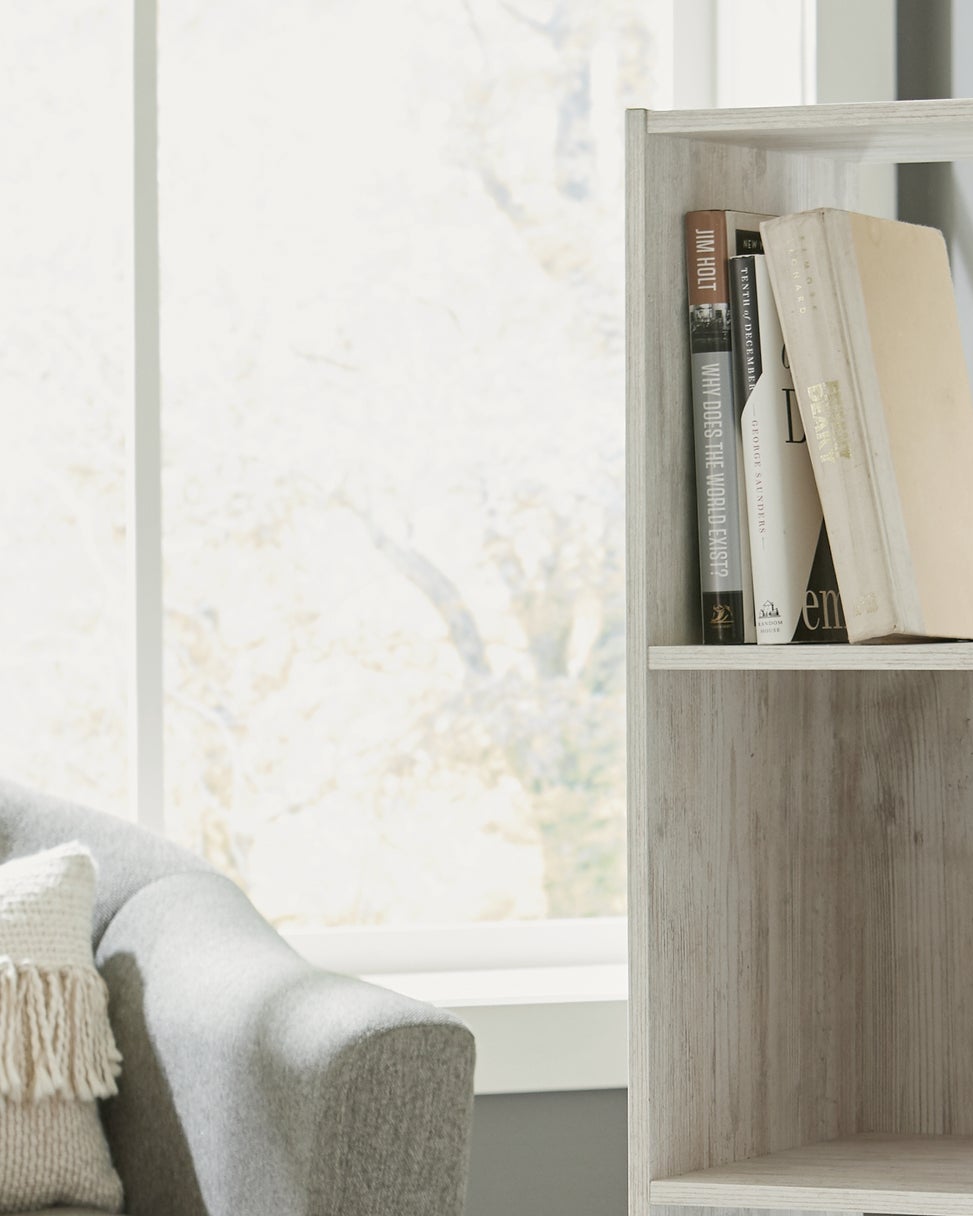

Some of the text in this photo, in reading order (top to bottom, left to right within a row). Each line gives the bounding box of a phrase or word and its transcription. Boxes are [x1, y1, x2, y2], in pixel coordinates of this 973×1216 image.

[696, 229, 717, 291] JIM HOLT
[743, 239, 757, 249] NEW
[740, 267, 757, 391] TENTH of DECEMBER
[701, 363, 728, 577] WHY DOES THE WORLD EXIST?
[751, 419, 766, 534] GEORGE SAUNDERS
